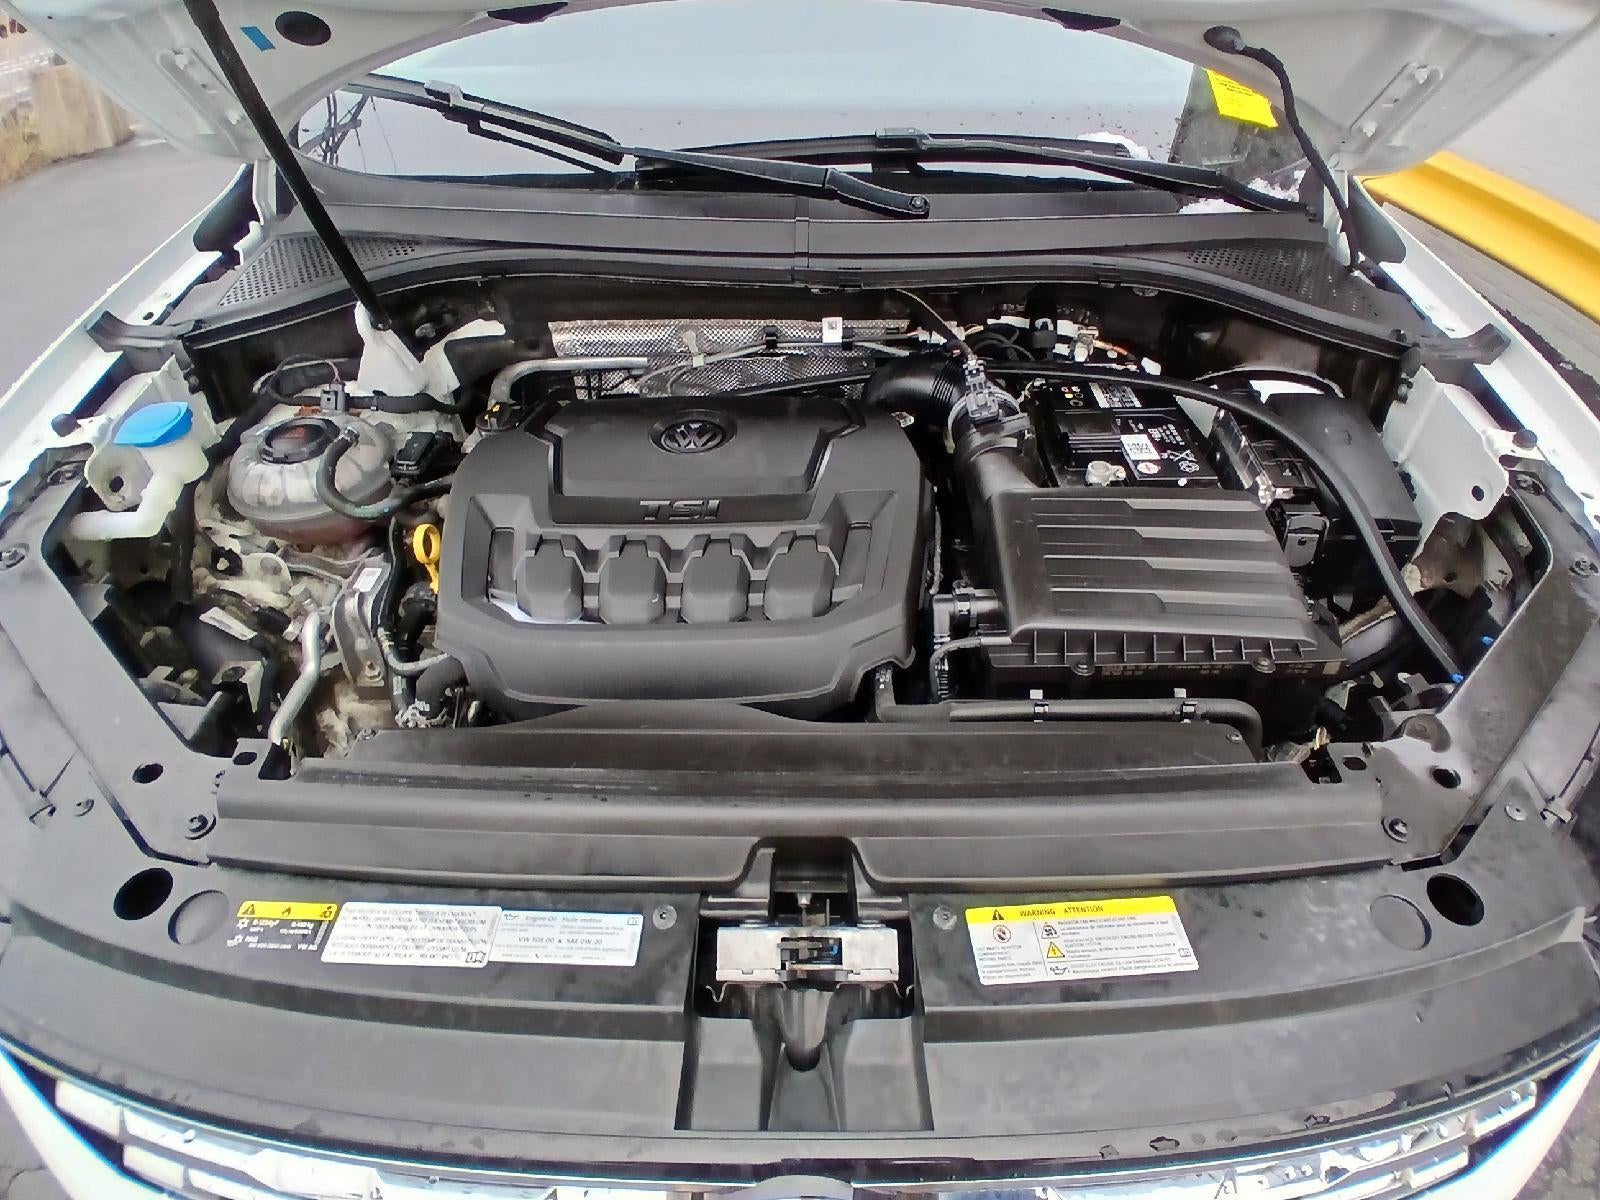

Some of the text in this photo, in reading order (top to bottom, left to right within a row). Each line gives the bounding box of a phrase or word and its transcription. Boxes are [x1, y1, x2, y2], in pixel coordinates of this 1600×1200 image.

[640, 499, 720, 520] TSI
[1019, 905, 1104, 918] WARNING ATTENTION
[525, 915, 547, 923] Engine
